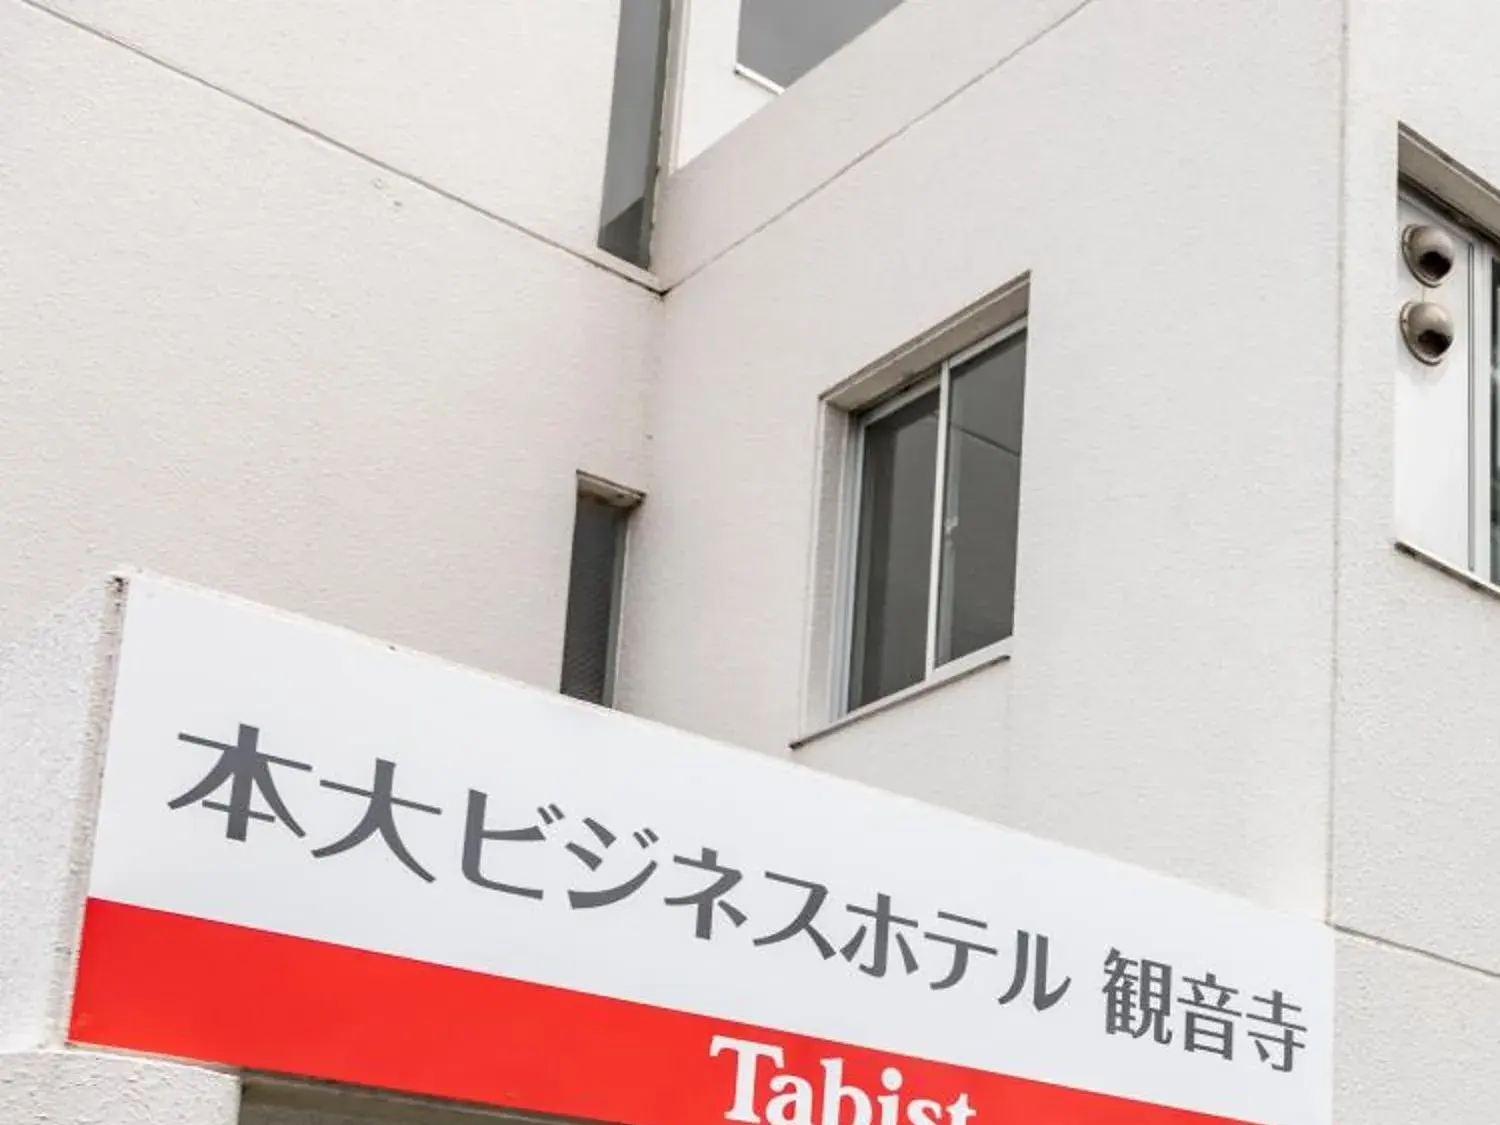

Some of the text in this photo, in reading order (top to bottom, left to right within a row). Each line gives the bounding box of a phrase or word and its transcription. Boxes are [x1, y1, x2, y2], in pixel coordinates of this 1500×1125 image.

[166, 722, 1308, 1074] 本大ビジネスホテル 観音寺
